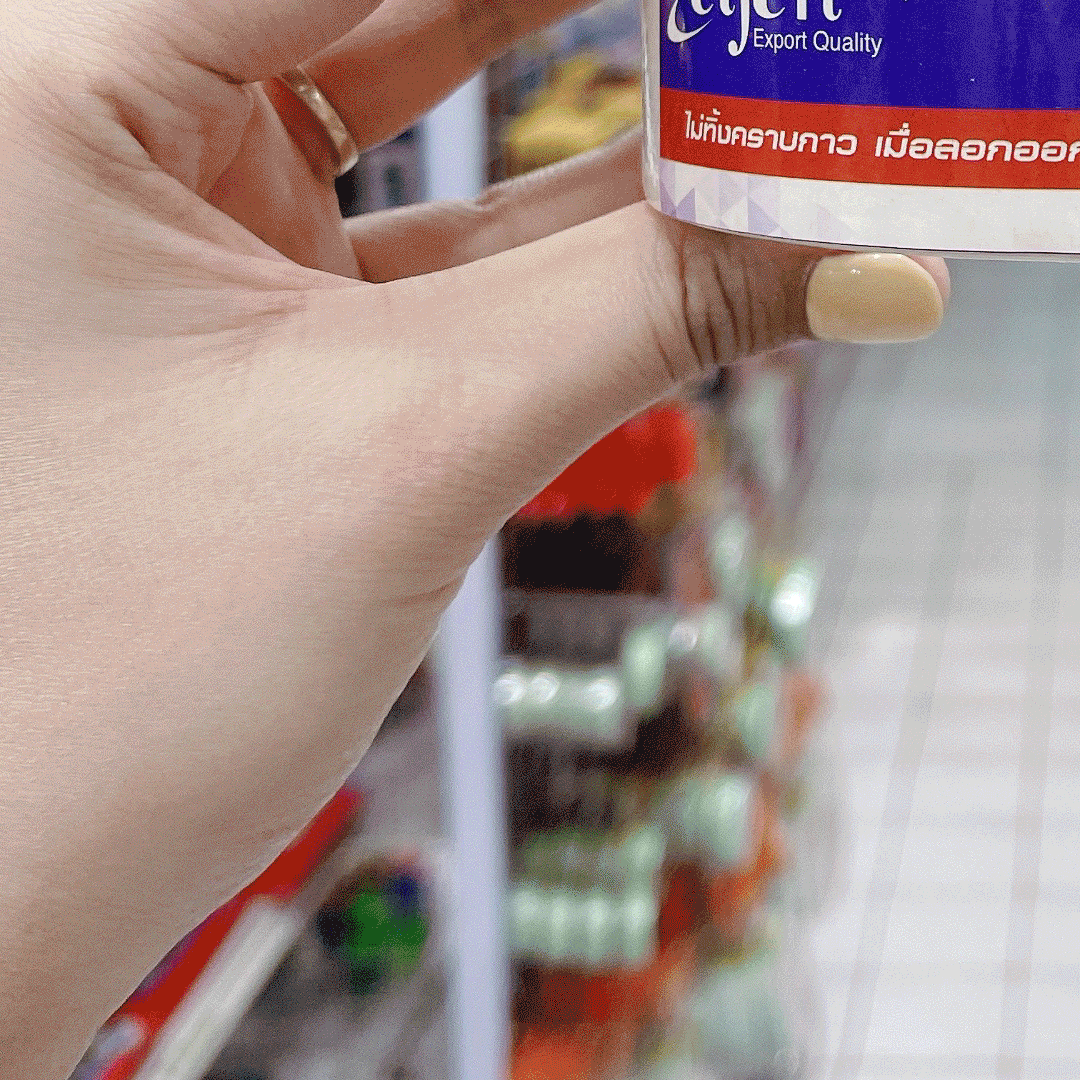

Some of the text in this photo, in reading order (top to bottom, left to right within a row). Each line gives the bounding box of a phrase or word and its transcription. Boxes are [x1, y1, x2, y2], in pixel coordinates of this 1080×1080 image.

[752, 27, 883, 58] Export Quality
[683, 108, 858, 156] ไม่ทิ้งคราบกาว
